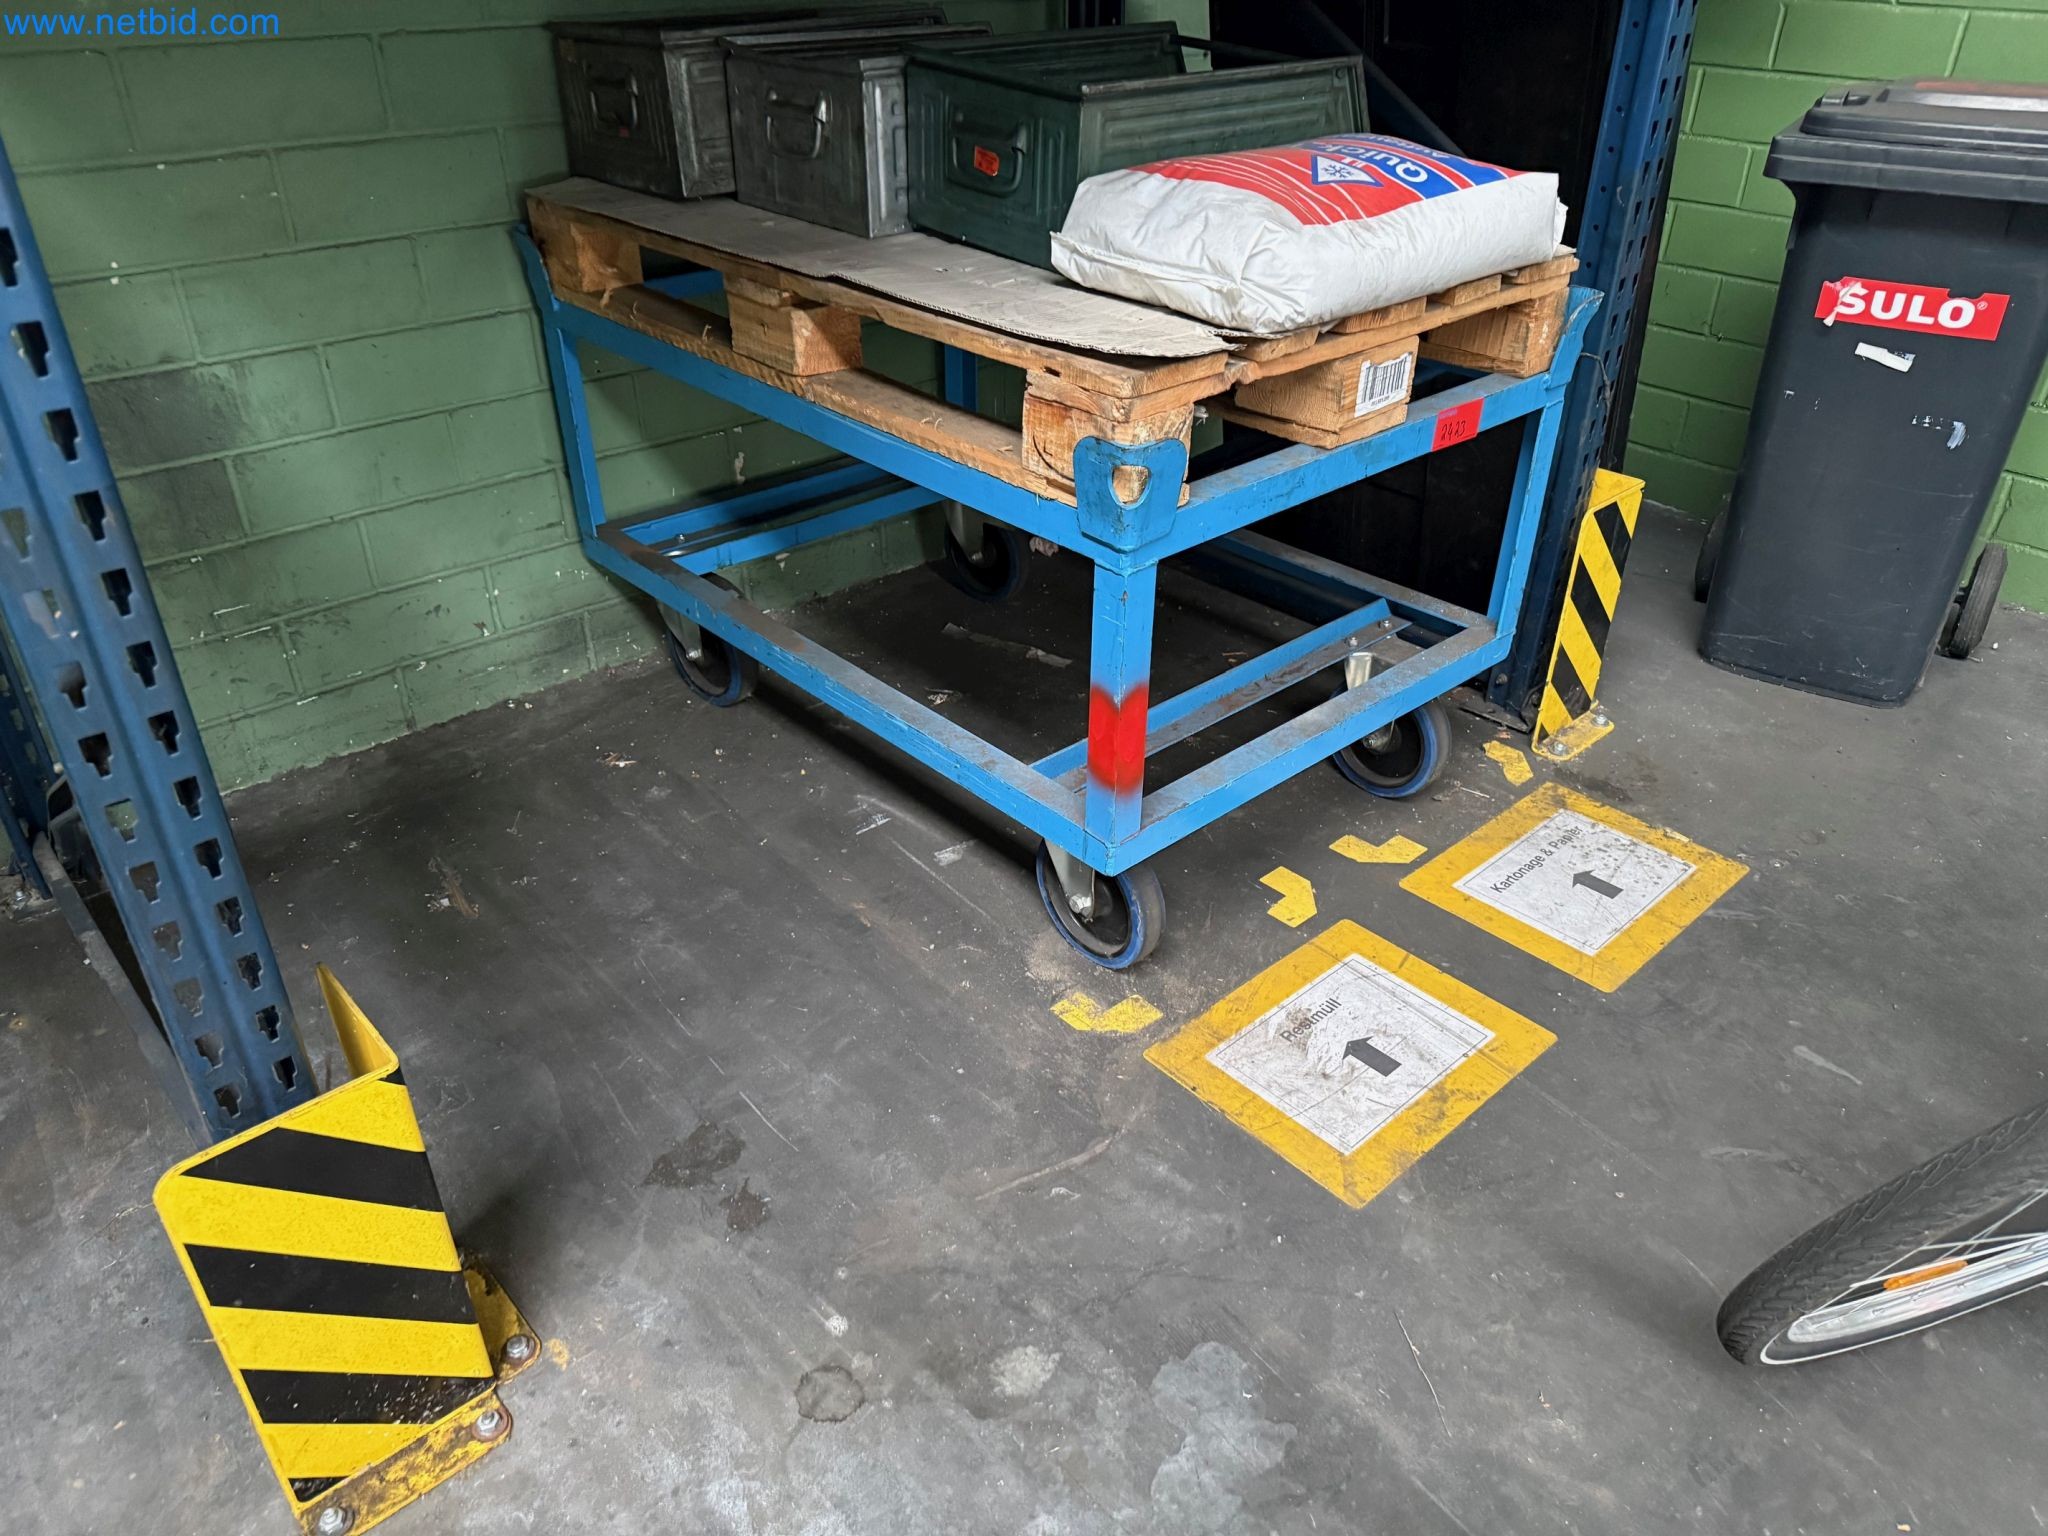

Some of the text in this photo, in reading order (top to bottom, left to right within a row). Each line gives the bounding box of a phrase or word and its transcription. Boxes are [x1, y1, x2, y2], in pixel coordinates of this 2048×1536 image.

[1319, 144, 1428, 183] Quick
[1835, 282, 1976, 329] SULO
[1489, 855, 1546, 894] Kartonage
[1548, 826, 1582, 849] Papier
[1279, 997, 1342, 1043] Restmüll
